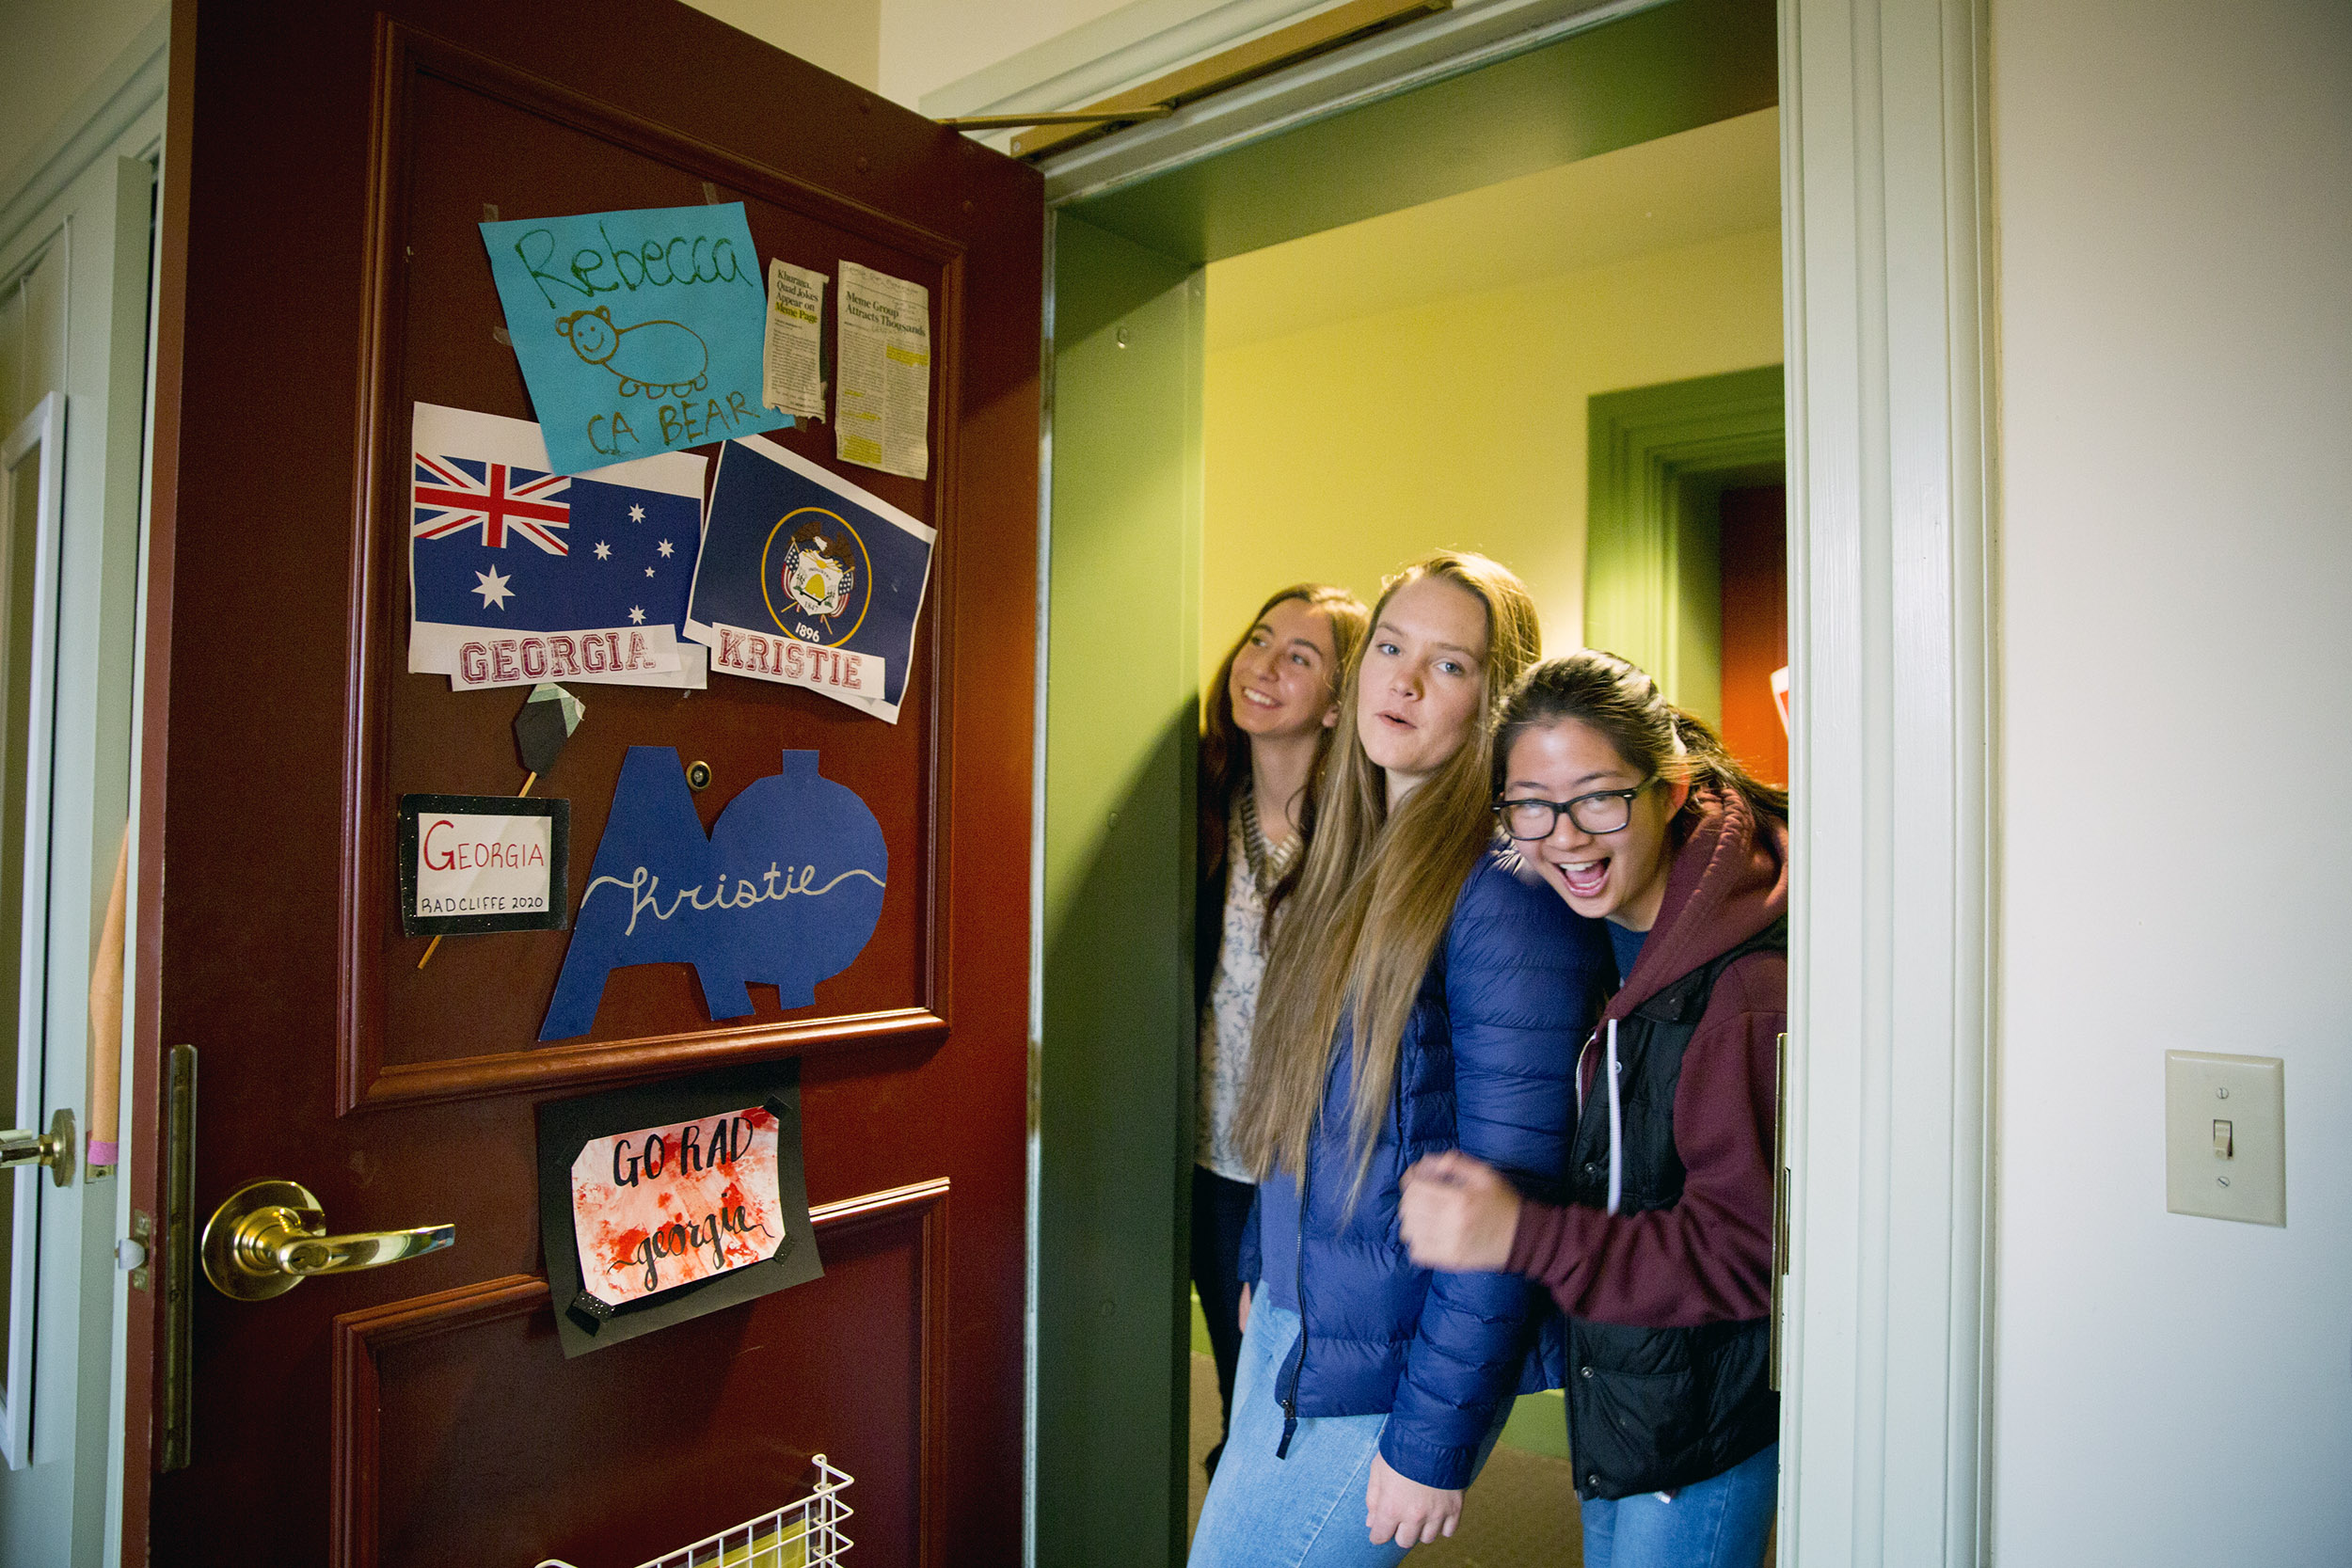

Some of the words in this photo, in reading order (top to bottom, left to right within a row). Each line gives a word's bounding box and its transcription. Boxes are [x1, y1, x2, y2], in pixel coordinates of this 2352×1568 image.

[515, 220, 754, 309] Rebecca
[776, 293, 803, 309] Appear
[803, 302, 815, 312] on
[777, 280, 797, 295] Quad
[797, 289, 818, 302] Jokes
[846, 290, 871, 309] Meme
[872, 301, 899, 320] Group
[775, 302, 798, 317] Meme
[799, 310, 818, 325] Page
[845, 304, 880, 323] Attracts
[880, 314, 926, 337] Thousands
[587, 410, 640, 456] CA
[659, 390, 761, 447] BEAR
[803, 601, 818, 612] 1847
[794, 622, 820, 642] 1896
[459, 631, 657, 684] GEORGIA
[717, 629, 863, 689] KRISTIE
[423, 819, 545, 872] GEORGIA
[421, 896, 506, 913] RADCLIFFE
[512, 896, 544, 910] 2020
[581, 862, 886, 937] Kristie
[612, 1133, 665, 1188] GO
[680, 1117, 754, 1176] RAD
